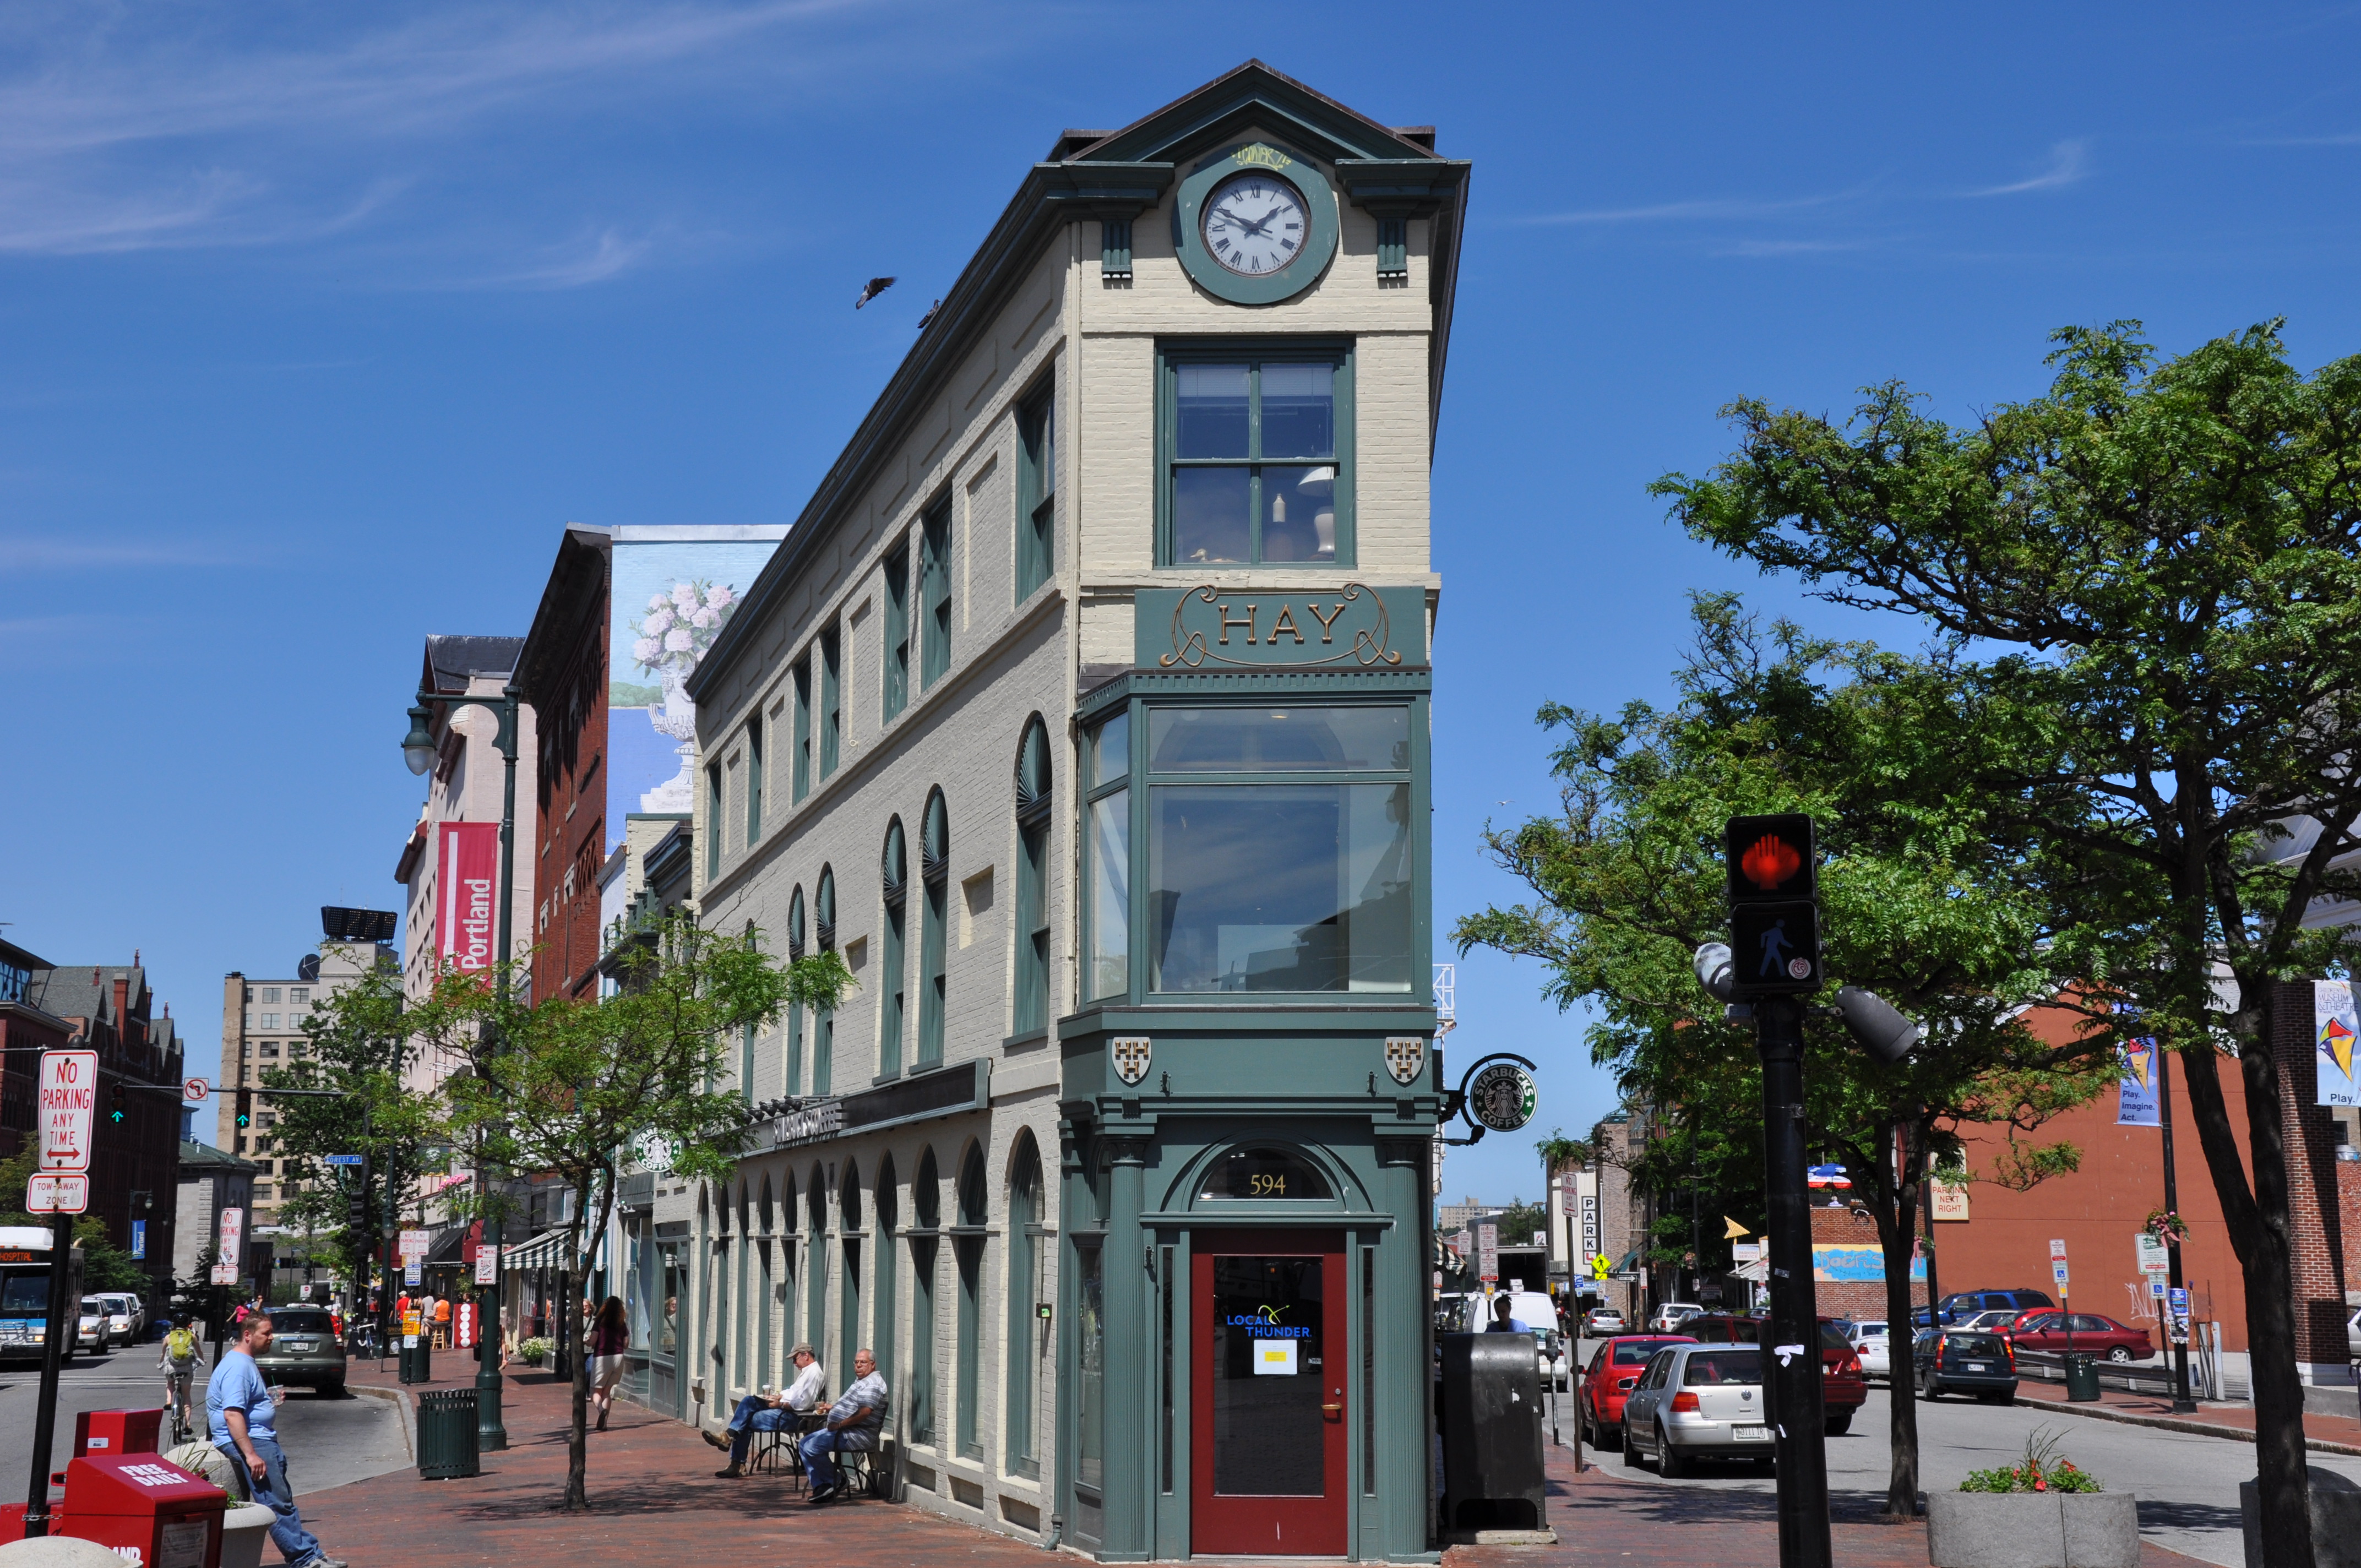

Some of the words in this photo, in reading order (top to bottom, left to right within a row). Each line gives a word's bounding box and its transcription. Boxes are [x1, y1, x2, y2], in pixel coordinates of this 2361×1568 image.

[1218, 605, 1345, 645] HAY
[461, 879, 490, 968] Portland
[2319, 993, 2348, 1002] MUSEUM
[56, 1062, 78, 1084] NO
[1475, 1068, 1534, 1097] STARBUCKS
[42, 1088, 90, 1110] PARKING
[2123, 1090, 2140, 1099] Play.
[2330, 1093, 2355, 1105] Play.
[2121, 1102, 2155, 1112] Imagine.
[52, 1113, 74, 1128] ANY
[1481, 1110, 1528, 1128] COFFEE
[2120, 1113, 2137, 1121] Act.
[50, 1131, 75, 1146] TIME
[636, 1127, 679, 1149] STARBS
[641, 1157, 674, 1170] COFFEE
[37, 1182, 79, 1191] TOW-AWAY
[1250, 1174, 1286, 1195] 594
[1565, 1177, 1572, 1185] NO
[1562, 1186, 1576, 1195] PARKING
[46, 1196, 68, 1205] ZONE
[224, 1213, 232, 1224] NO
[1585, 1199, 1593, 1248] PARK
[220, 1226, 238, 1236] ARKING
[0, 1252, 32, 1261] HOSPITAL
[1227, 1315, 1271, 1325] LOCAL
[117, 1463, 170, 1477] FREE
[132, 1473, 189, 1487] DAILY
